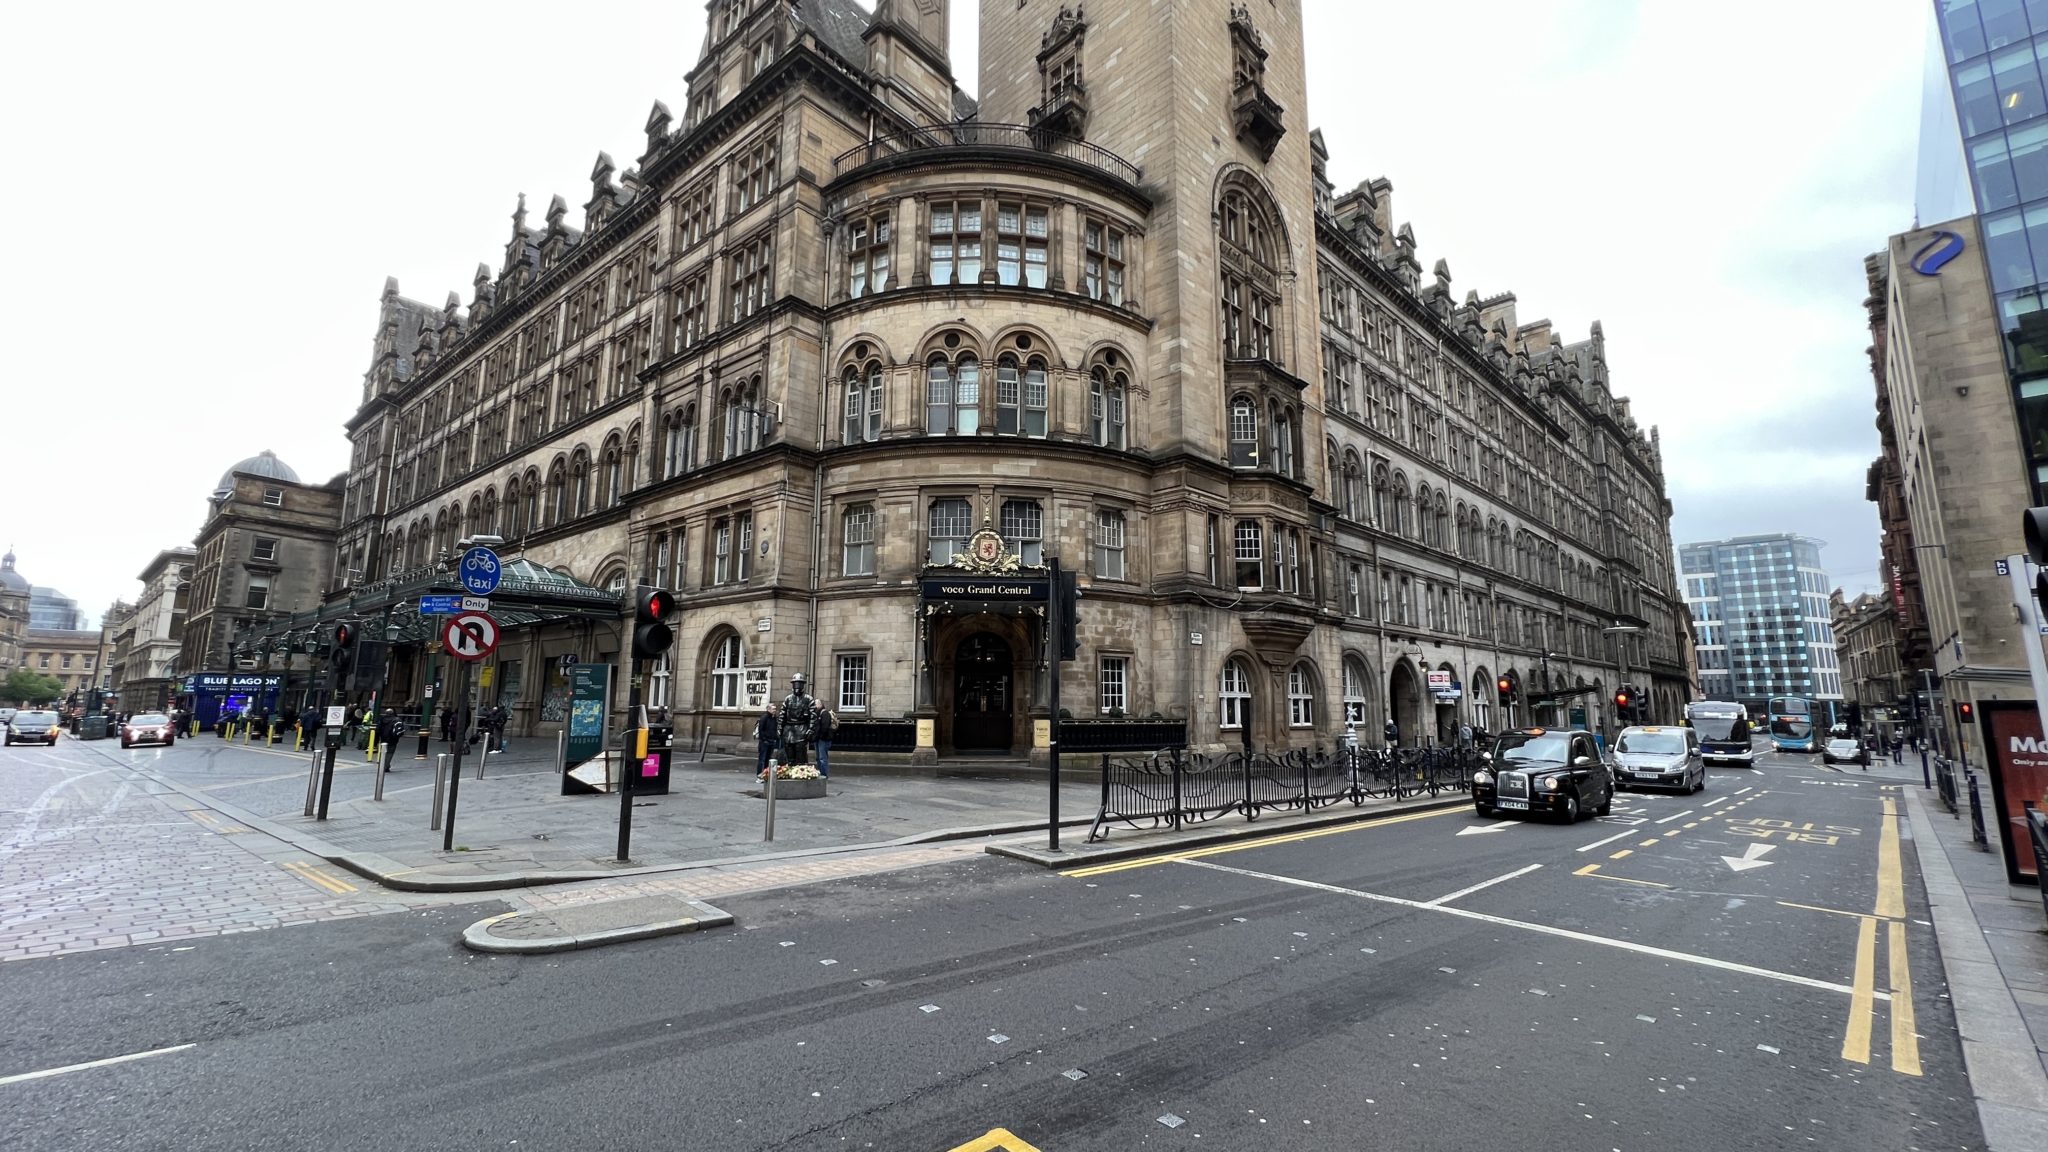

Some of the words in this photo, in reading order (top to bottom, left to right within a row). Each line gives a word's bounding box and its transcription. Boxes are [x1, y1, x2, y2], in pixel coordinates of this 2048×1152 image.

[468, 575, 491, 590] taxi
[942, 586, 964, 594] voco
[967, 585, 996, 594] Grand
[998, 586, 1031, 595] Central
[465, 600, 486, 609] Only
[204, 677, 228, 685] BLUE
[747, 670, 768, 681] OUTGOING
[746, 683, 767, 694] VEHICLES
[750, 696, 763, 707] ONLY
[1725, 817, 1862, 836] STOP
[1724, 826, 1839, 846] BUS
